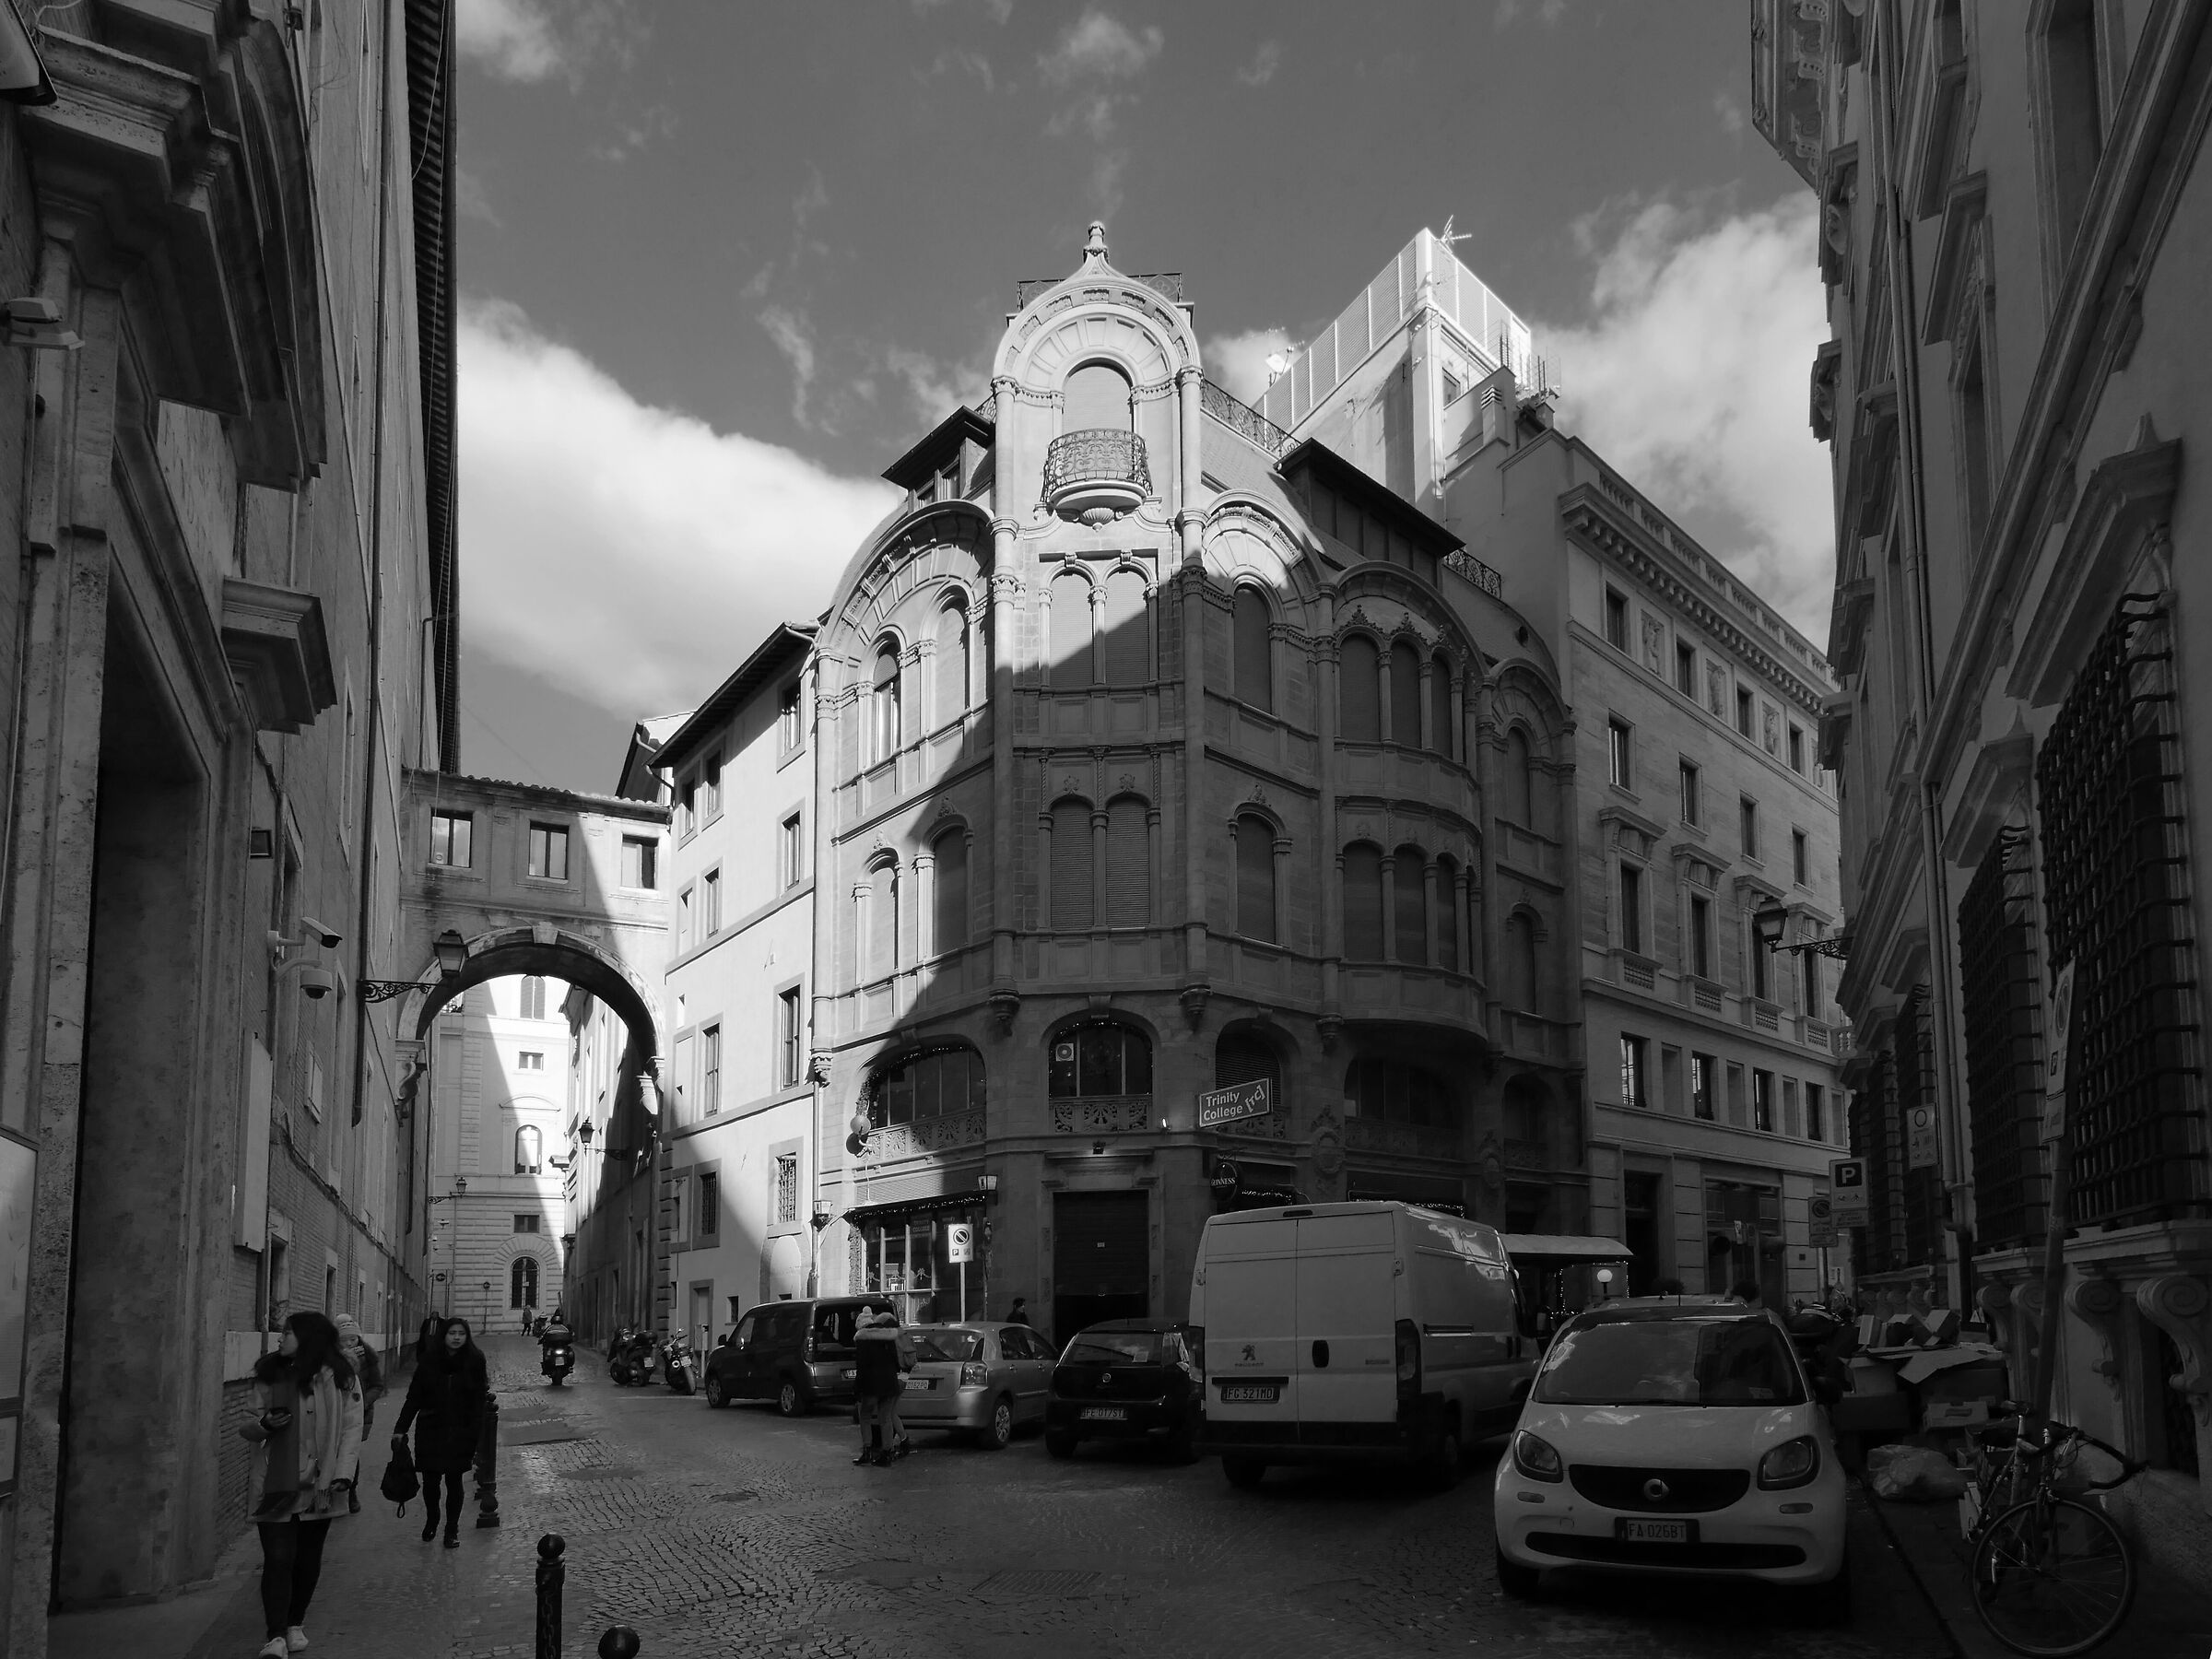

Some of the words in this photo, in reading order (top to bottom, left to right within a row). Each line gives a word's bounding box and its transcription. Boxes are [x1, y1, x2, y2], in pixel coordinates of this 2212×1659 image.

[1206, 1091, 1240, 1107] Trinity
[1203, 1105, 1243, 1121] College
[1841, 1167, 1856, 1183] P
[1629, 1524, 1644, 1537] FA
[1647, 1524, 1686, 1539] 026BT
